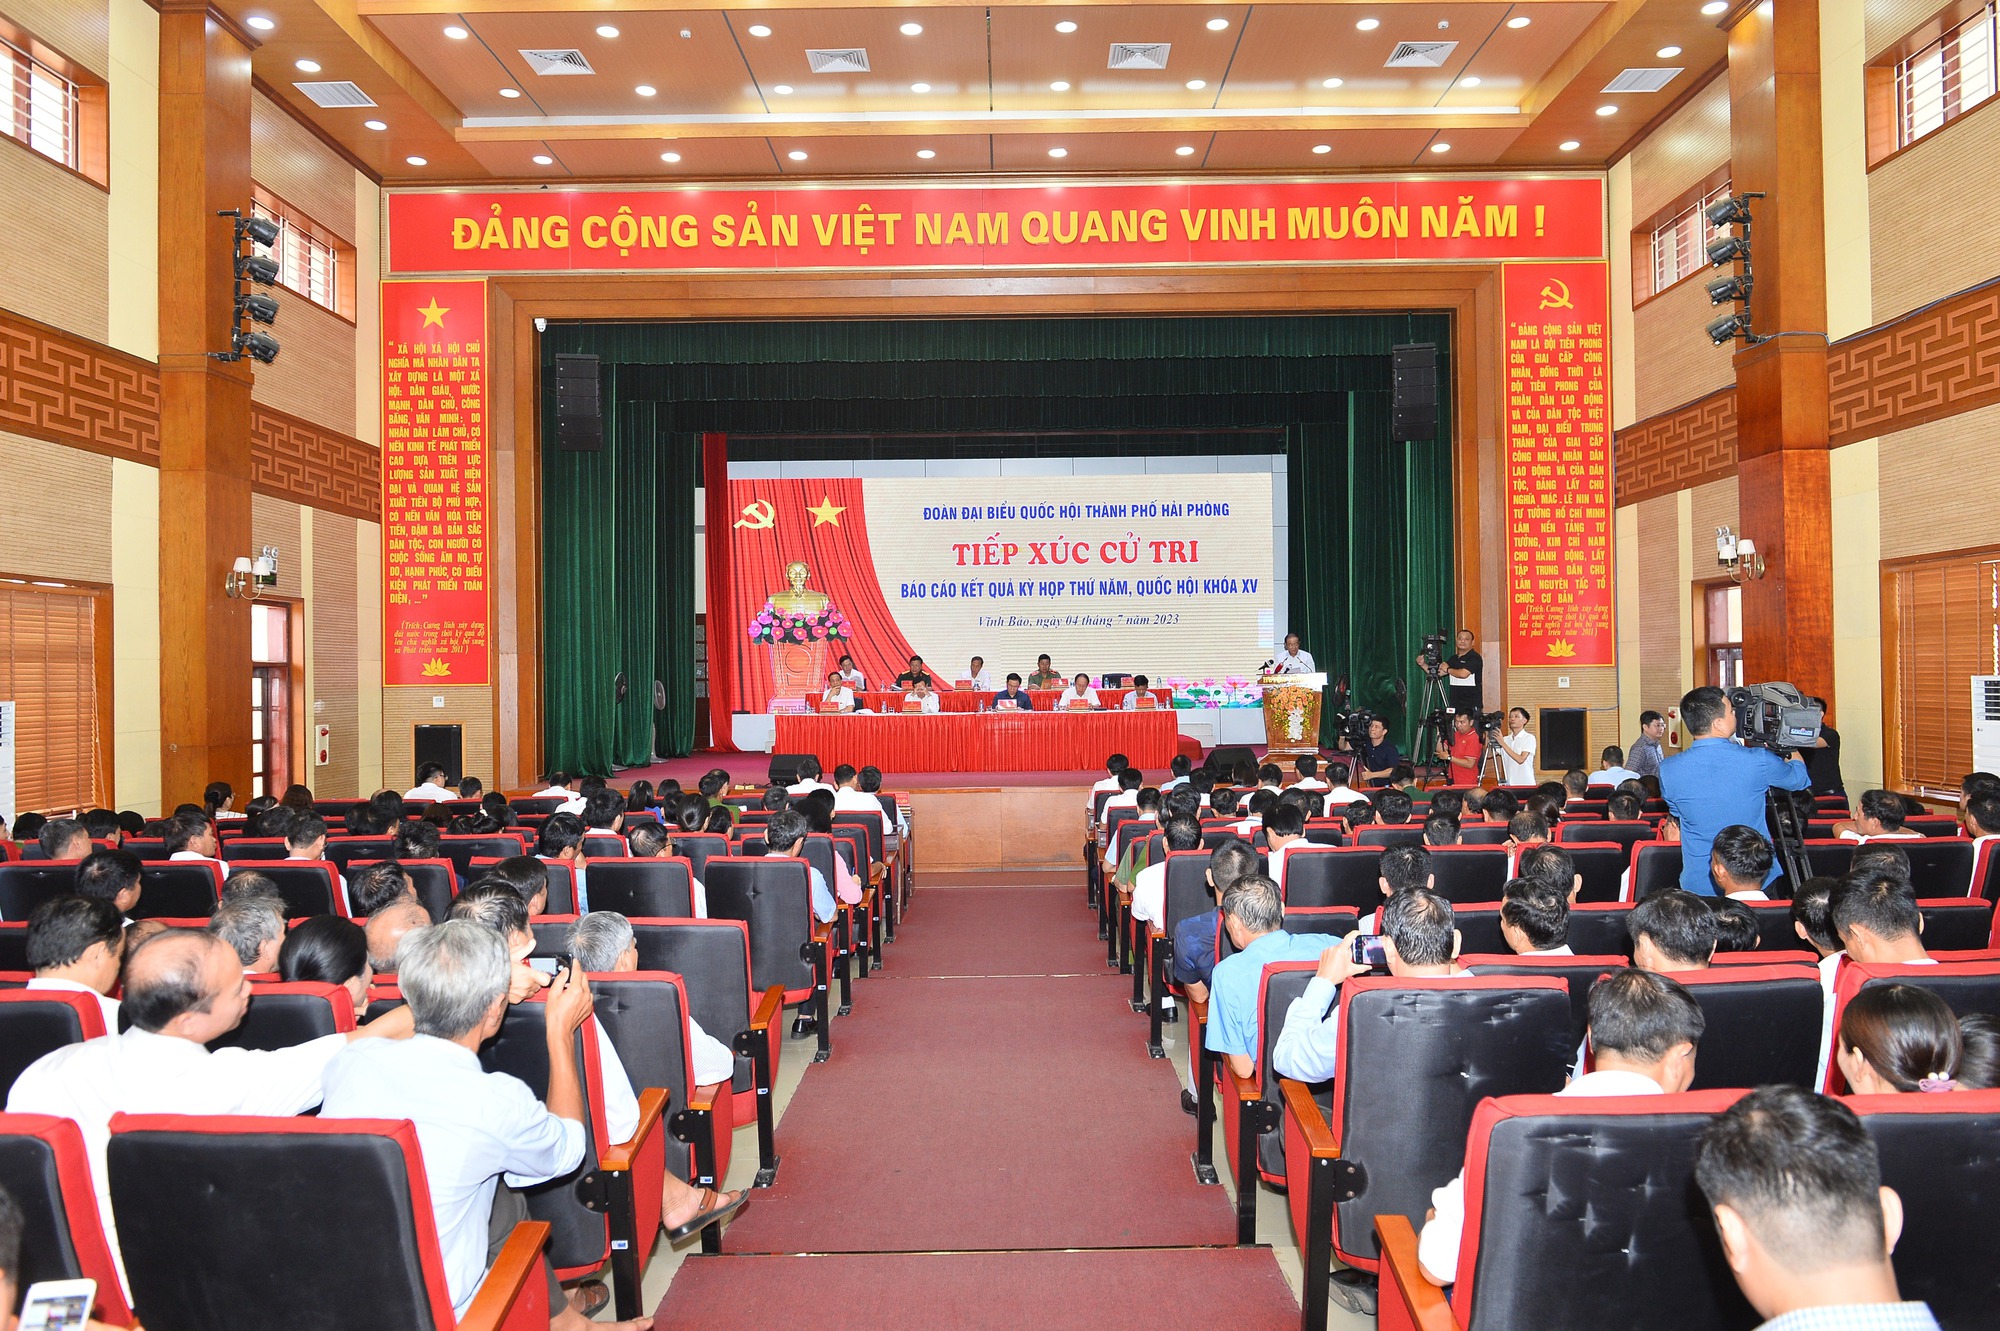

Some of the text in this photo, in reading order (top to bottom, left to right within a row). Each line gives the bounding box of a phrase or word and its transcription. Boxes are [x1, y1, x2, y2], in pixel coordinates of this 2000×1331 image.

[451, 195, 1545, 256] ĐẢNG CỘNG SẢN VIỆT NAM QUANG VINH MUÔN NĂM !
[1568, 322, 1582, 335] SẢN
[466, 340, 480, 353] CHỦ
[1511, 337, 1602, 349] NAM TIÊN PHONG
[428, 356, 449, 368] NHÂN
[453, 355, 468, 367] DÂN
[471, 357, 480, 367] TA
[1511, 350, 1603, 363] CỦA GIAI CÔNG
[389, 369, 402, 382] XÂY
[410, 384, 425, 396] DÂN
[1530, 377, 1603, 391] TIÊN PHONG CỦA
[418, 398, 434, 410] DÂN
[462, 397, 480, 409] CÔNG
[1511, 393, 1575, 405] NHÂN DÂN LAO
[416, 412, 480, 424] VĂN DO
[1526, 406, 1562, 419] CỦA DÂN
[389, 425, 410, 438] NHÂN
[413, 425, 428, 438] DÂN
[1512, 424, 1532, 435] NAM,
[1580, 423, 1604, 432] TRUNG
[407, 442, 424, 451] KINH
[1544, 434, 1557, 447] CỦA
[1566, 437, 1581, 447] GIAI
[389, 453, 457, 465] CAO TRÊN
[1512, 449, 1604, 461] CÔNG NHÂN DÂN
[420, 466, 434, 479] SẢN
[1512, 463, 1604, 476] LAO CỦA DÂN
[424, 484, 444, 493] QUAN
[467, 480, 481, 493] SẢN
[1590, 477, 1604, 489] CHỦ
[1576, 494, 1589, 504] NIN
[426, 509, 440, 521] VĂN
[465, 509, 482, 521] TIÊN
[923, 500, 1230, 522] ĐOÀN ĐẠI BIỂU QUỐC HỘI THÀNH PHỐ HẢI PHÒNG
[1586, 508, 1606, 517] MINH
[448, 522, 463, 535] BẢN
[1565, 520, 1584, 533] TẢNG
[389, 538, 405, 549] DÂN
[428, 540, 444, 549] CON
[1547, 534, 1606, 547] KIM CHỈ NAM
[952, 531, 1199, 566] TIẾP XÚC CỬ TRI
[457, 553, 469, 564] NO,
[1514, 552, 1528, 561] CHO
[390, 567, 402, 578] DO,
[405, 567, 425, 578] HẠNH
[1535, 562, 1606, 575] TRUNG DÂN CHỦ
[901, 575, 1258, 599] BÁO CÁO KẾT QUẢ KỲ HỌP THỨ NĂM, QUỐC HỘI KHÓA XV
[1539, 577, 1568, 589] NGUYÊN
[979, 614, 1179, 628] Vĩnh Bảo, ngày 04 tháng 7 năm 2023
